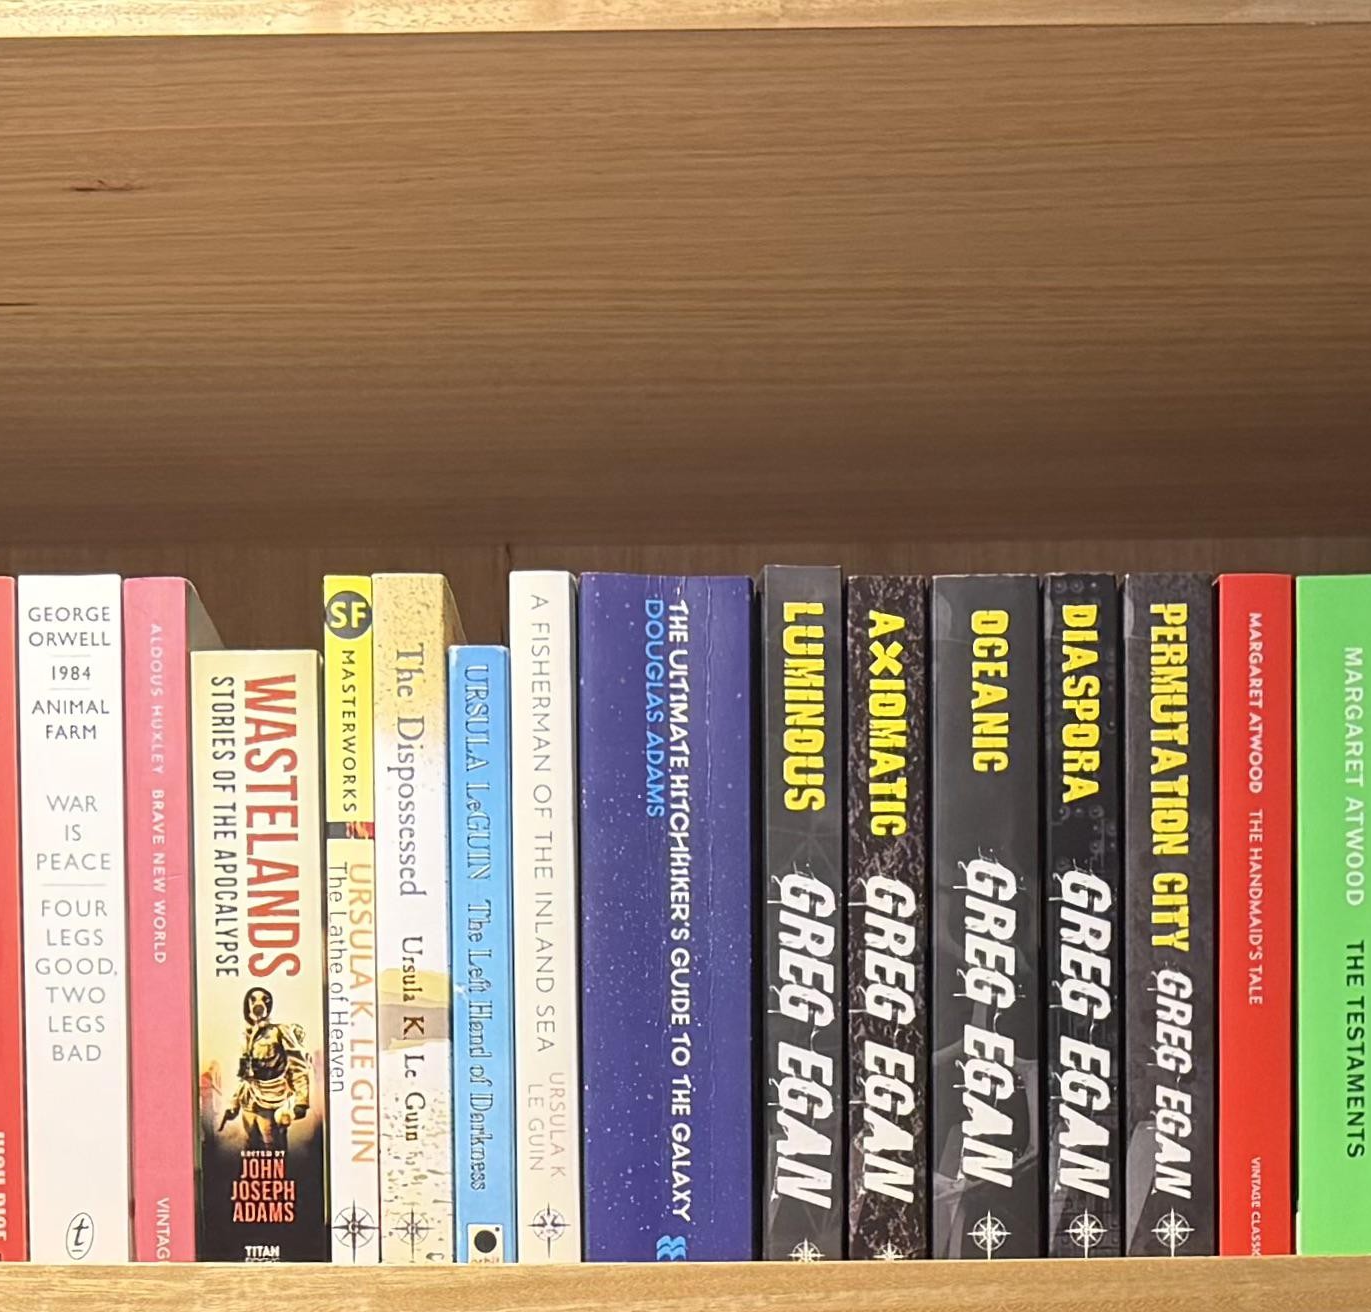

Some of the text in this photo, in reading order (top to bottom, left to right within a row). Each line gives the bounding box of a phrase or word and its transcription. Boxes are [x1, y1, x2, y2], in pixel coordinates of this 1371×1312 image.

[28, 606, 110, 622] GEORGE
[332, 602, 367, 628] SF
[28, 631, 111, 646] ORWELL
[50, 666, 91, 681] 1984
[972, 610, 1008, 773] OCEANIC
[32, 700, 110, 715] ANIMAL
[644, 599, 664, 817] DOUGLAS ADAMS
[45, 724, 97, 740] FARM
[342, 650, 357, 813] MASTERWORKS
[1150, 603, 1190, 951] PERMUTATION CITY
[1344, 646, 1365, 906] MARGARET ATWOOD
[46, 795, 97, 812] WAR
[64, 824, 82, 841] IS
[211, 676, 239, 977] STORIES OF THE APOCALYPSE
[244, 674, 301, 979] WASTELANDS
[36, 853, 111, 871] PEACE
[1346, 939, 1365, 1159] THE TESTAMENTS
